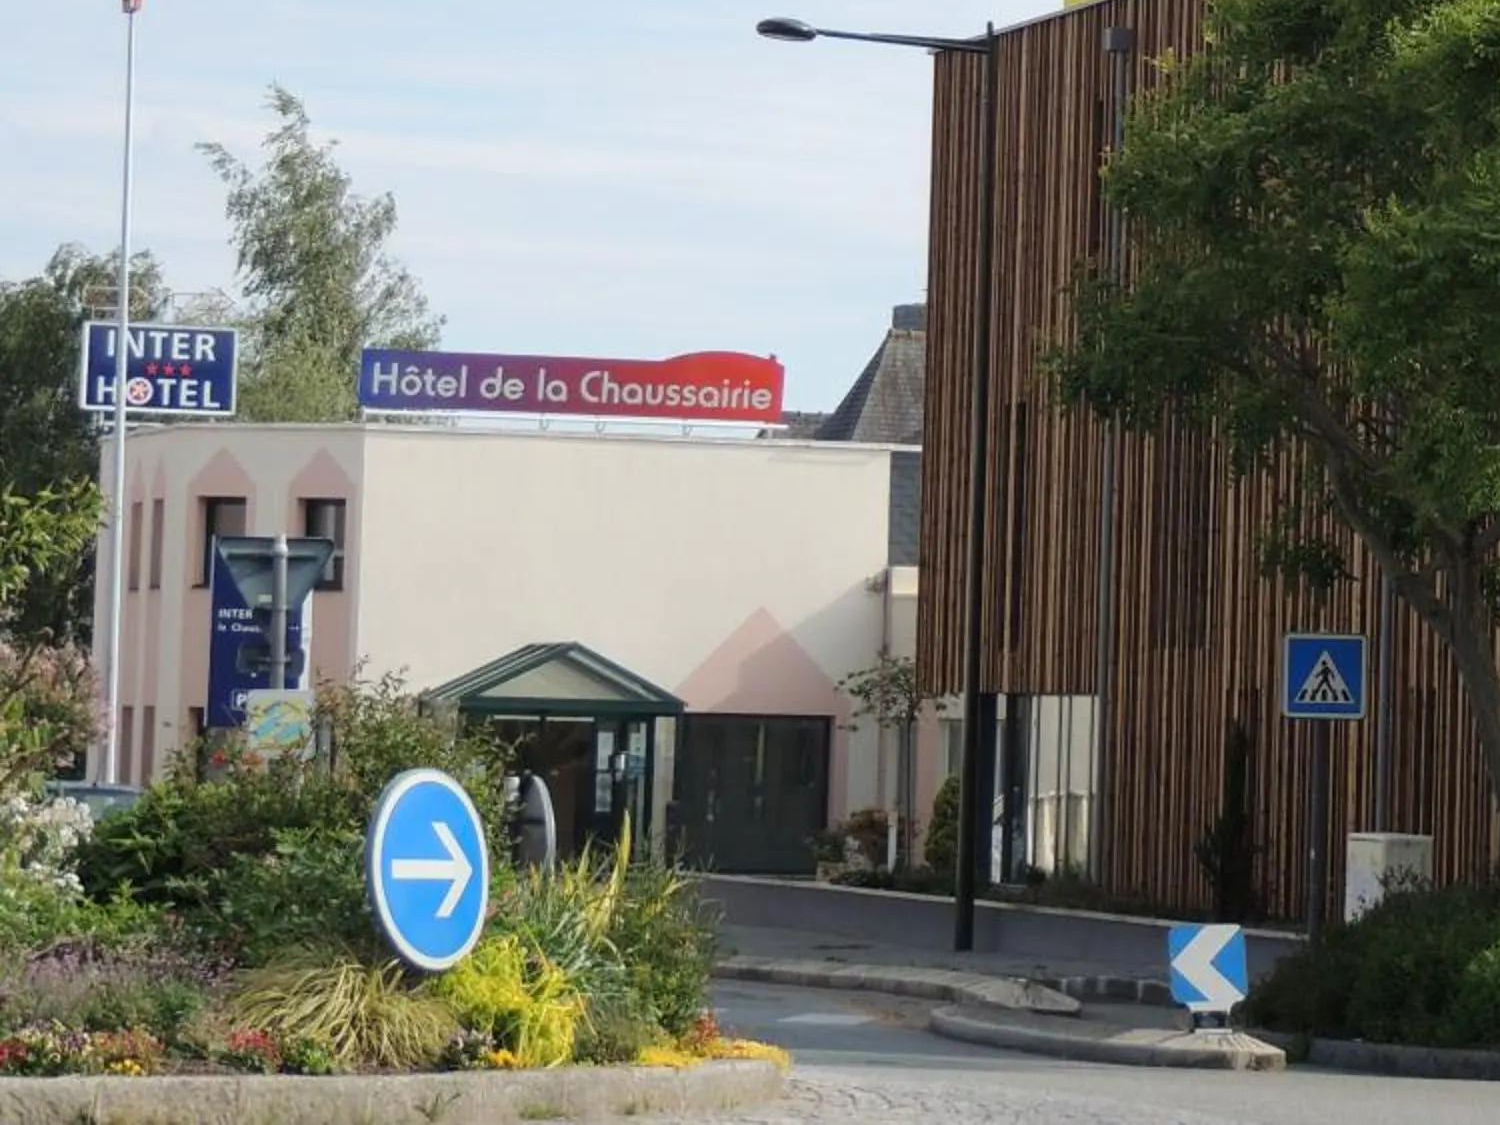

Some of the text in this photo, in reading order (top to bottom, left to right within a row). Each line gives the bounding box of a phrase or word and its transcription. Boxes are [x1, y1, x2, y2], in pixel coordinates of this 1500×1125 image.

[106, 329, 216, 362] INTER
[96, 374, 221, 409] HOTEL
[371, 361, 773, 410] Hôtel de la Chaussairie
[217, 608, 253, 619] INTER
